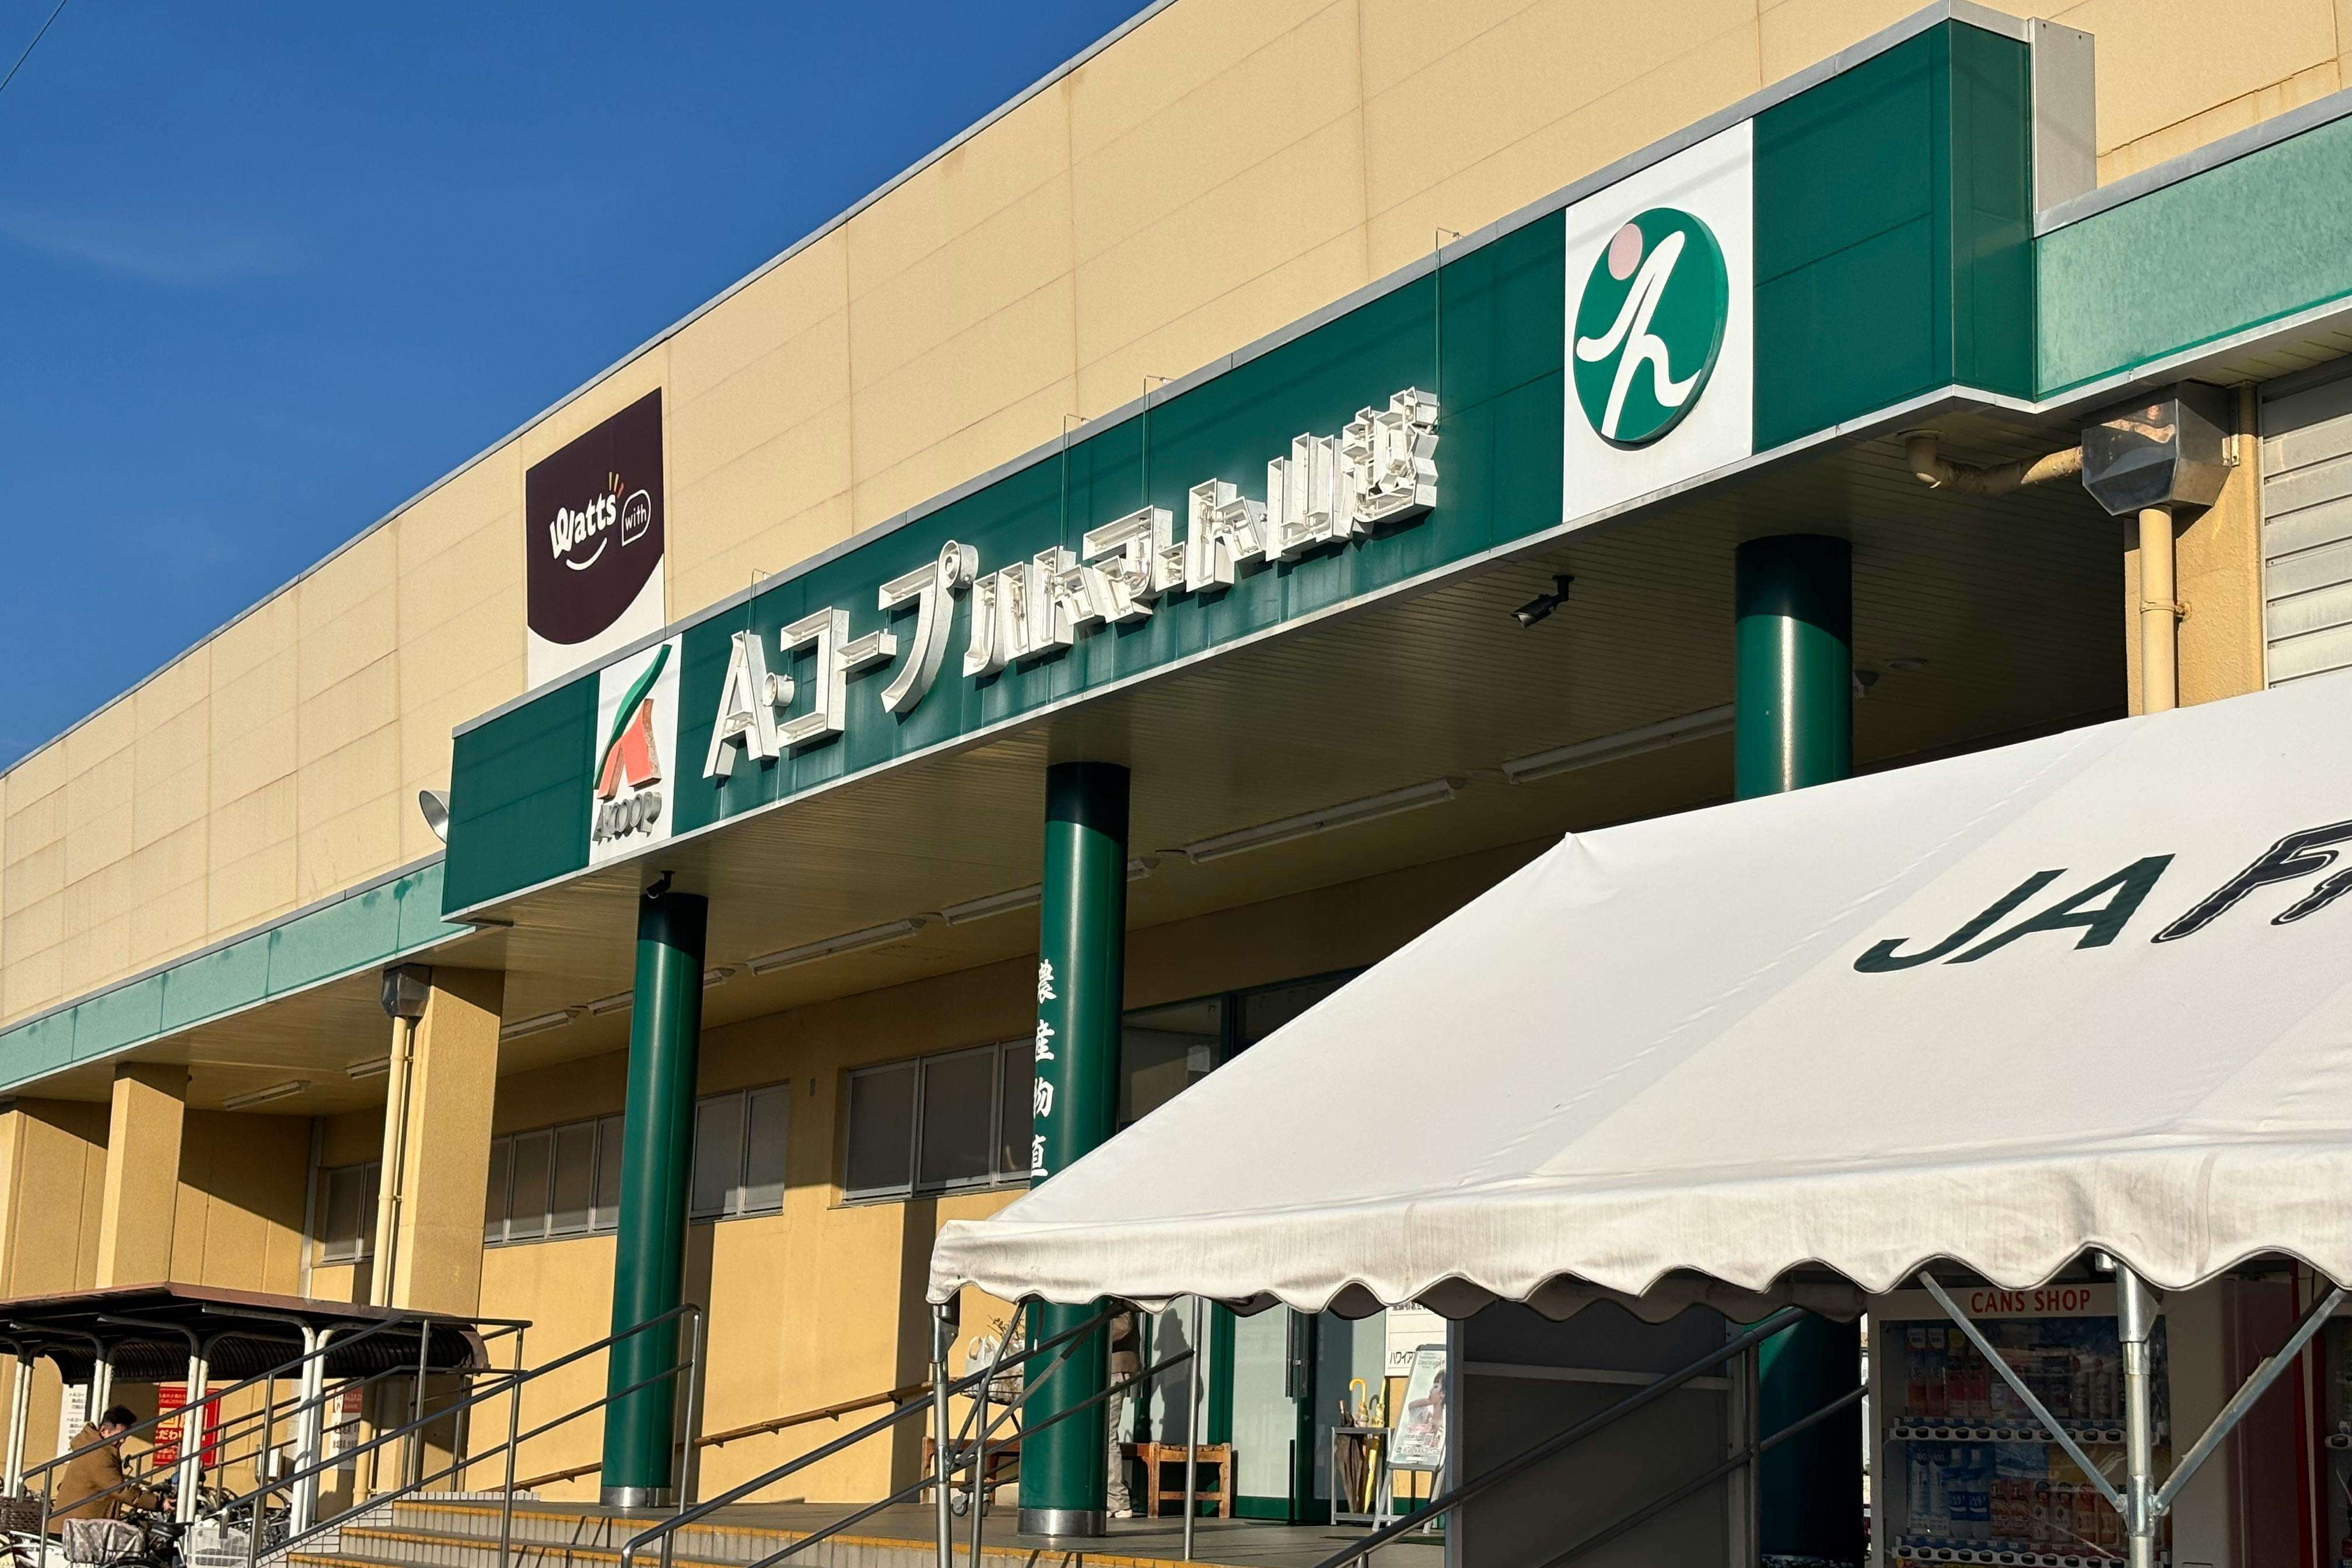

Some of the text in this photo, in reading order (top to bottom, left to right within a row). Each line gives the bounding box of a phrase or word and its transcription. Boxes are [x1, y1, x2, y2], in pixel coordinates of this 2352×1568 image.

[549, 493, 617, 559] Watts
[625, 503, 647, 531] with
[1853, 853, 2176, 973] JA
[1971, 1289, 2091, 1313] CANS SHOP
